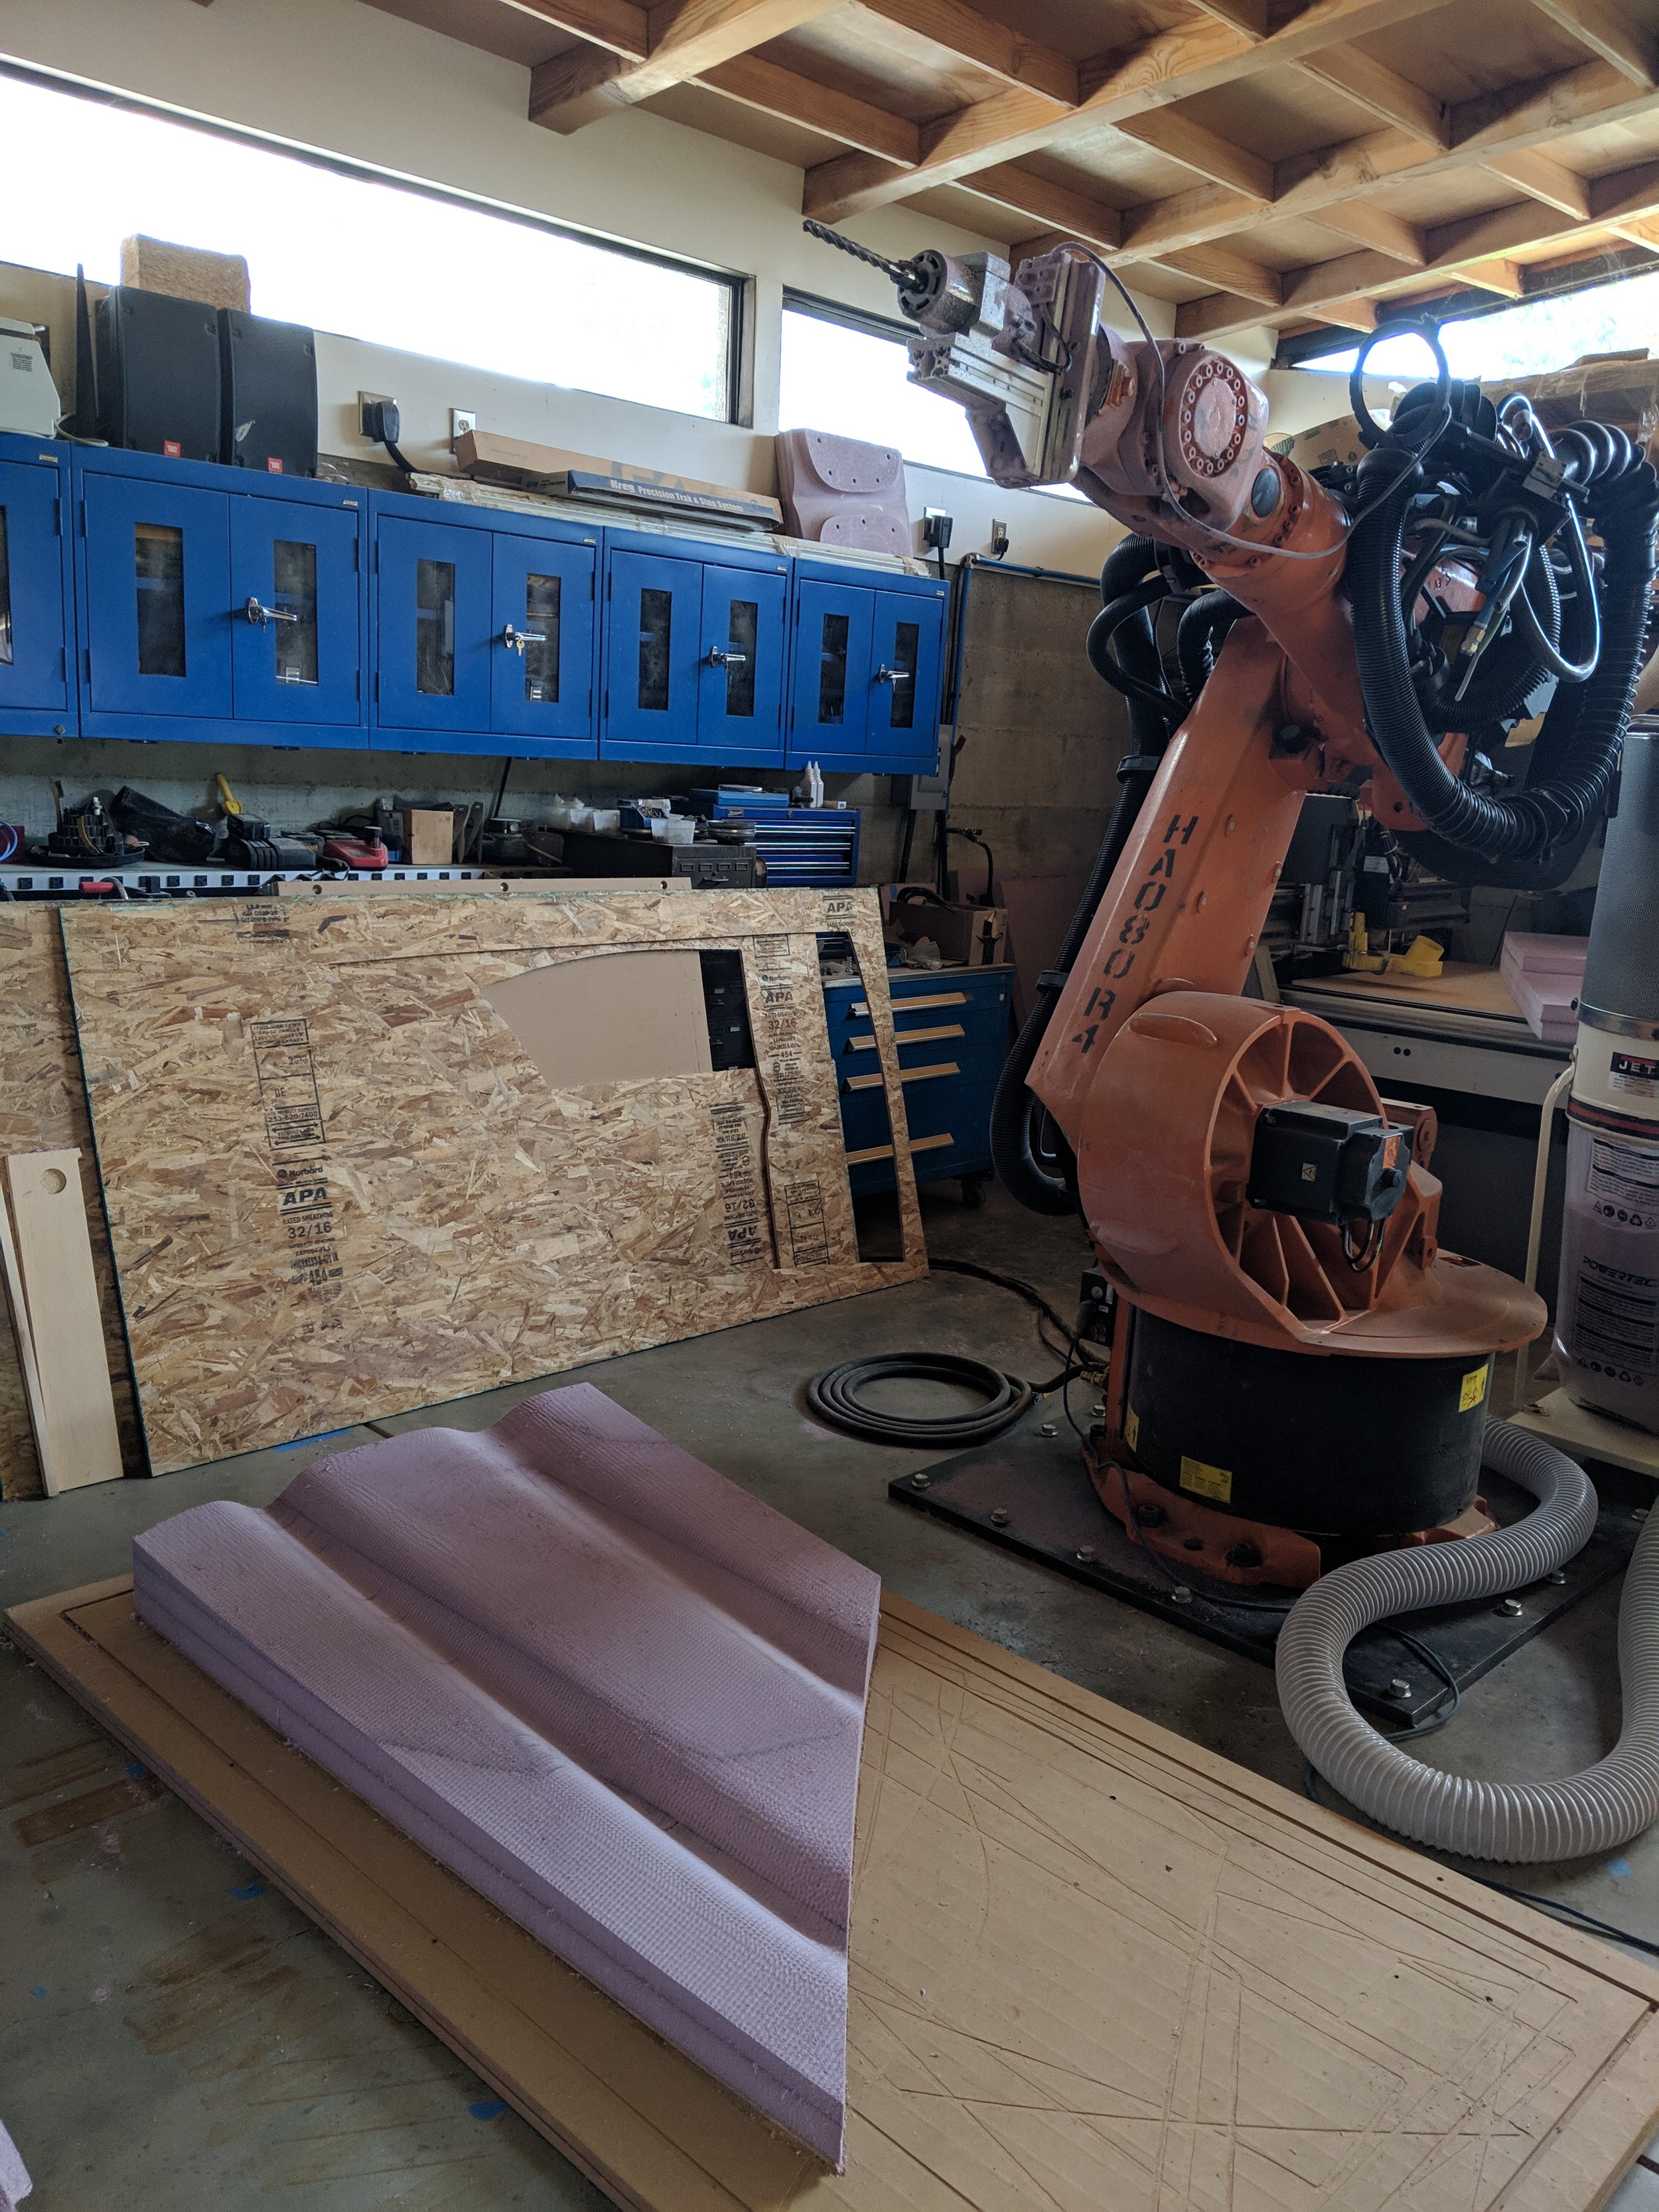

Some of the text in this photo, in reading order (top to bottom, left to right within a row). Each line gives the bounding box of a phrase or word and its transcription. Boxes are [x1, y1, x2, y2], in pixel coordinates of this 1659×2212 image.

[610, 479, 635, 494] Kreg
[638, 485, 676, 500] Precision
[676, 492, 693, 502] Trak
[699, 496, 717, 508] Stop
[717, 500, 744, 512] System
[765, 991, 794, 1003] APA
[768, 1018, 796, 1031] 32/16
[1619, 1061, 1656, 1074] JET
[268, 1111, 318, 1122] 253-620-7400
[289, 1166, 323, 1177] Norbord
[283, 1187, 328, 1205] APA
[725, 1199, 755, 1213] 32/16
[283, 1211, 333, 1225] RATED SHEATHING
[288, 1221, 332, 1239] 32/16
[727, 1225, 757, 1241] APA
